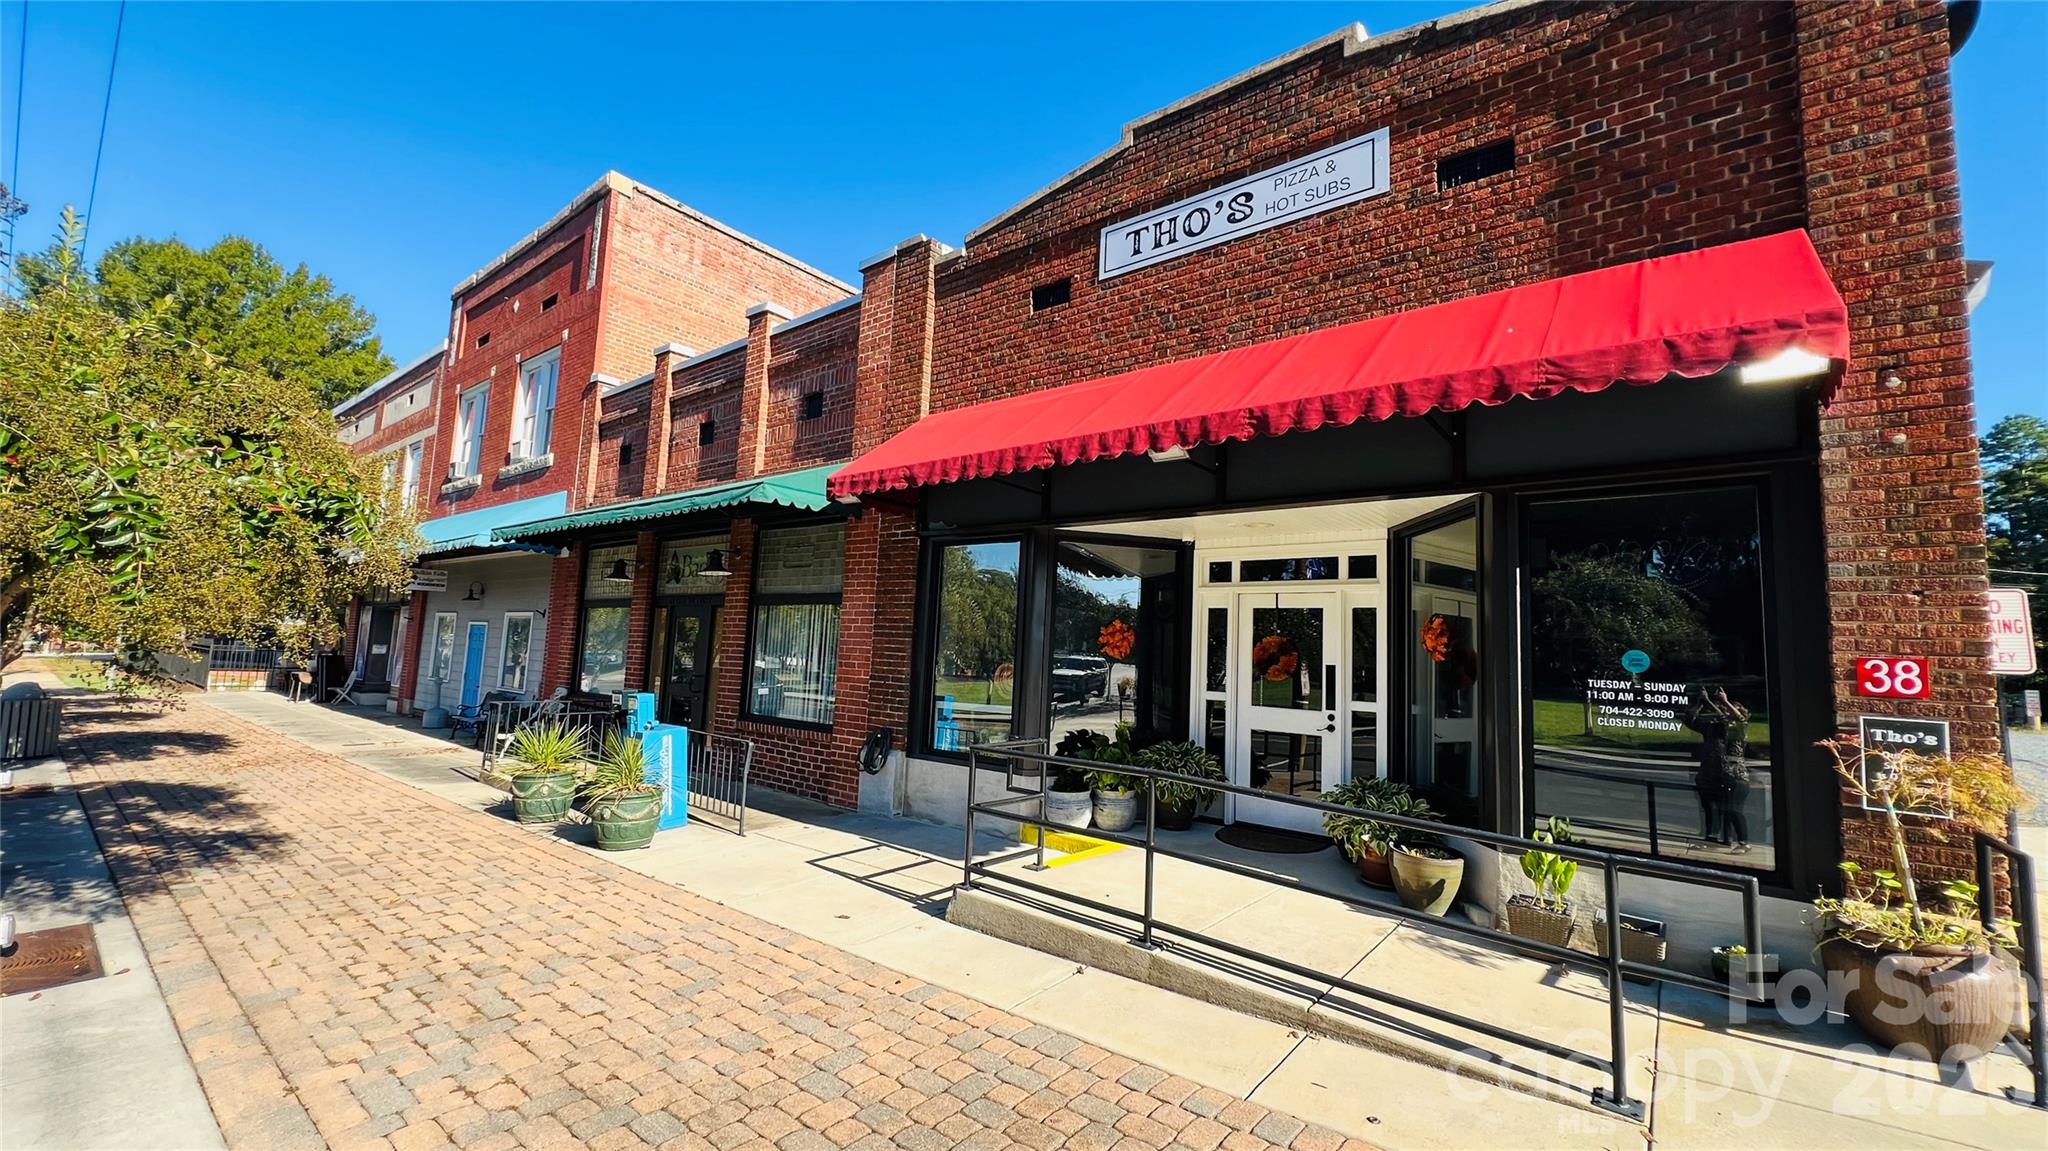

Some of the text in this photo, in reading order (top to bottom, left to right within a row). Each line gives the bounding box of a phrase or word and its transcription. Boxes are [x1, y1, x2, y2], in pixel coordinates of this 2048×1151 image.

[1273, 159, 1337, 192] PIZZA &
[1265, 177, 1352, 216] HOT SUBS
[1125, 191, 1255, 258] THO'S
[1587, 679, 1632, 690] TUESDAY
[1643, 682, 1686, 692] SUNDAY
[1863, 659, 1923, 695] 38
[1586, 690, 1616, 700] 11:00
[1617, 692, 1634, 701] AM
[1643, 694, 1669, 704] 9:00
[1671, 695, 1689, 705] PM
[1599, 705, 1675, 719] 704-422-3090
[1597, 717, 1682, 731] CLOSED MONDAY
[1870, 728, 1939, 746] Tho's
